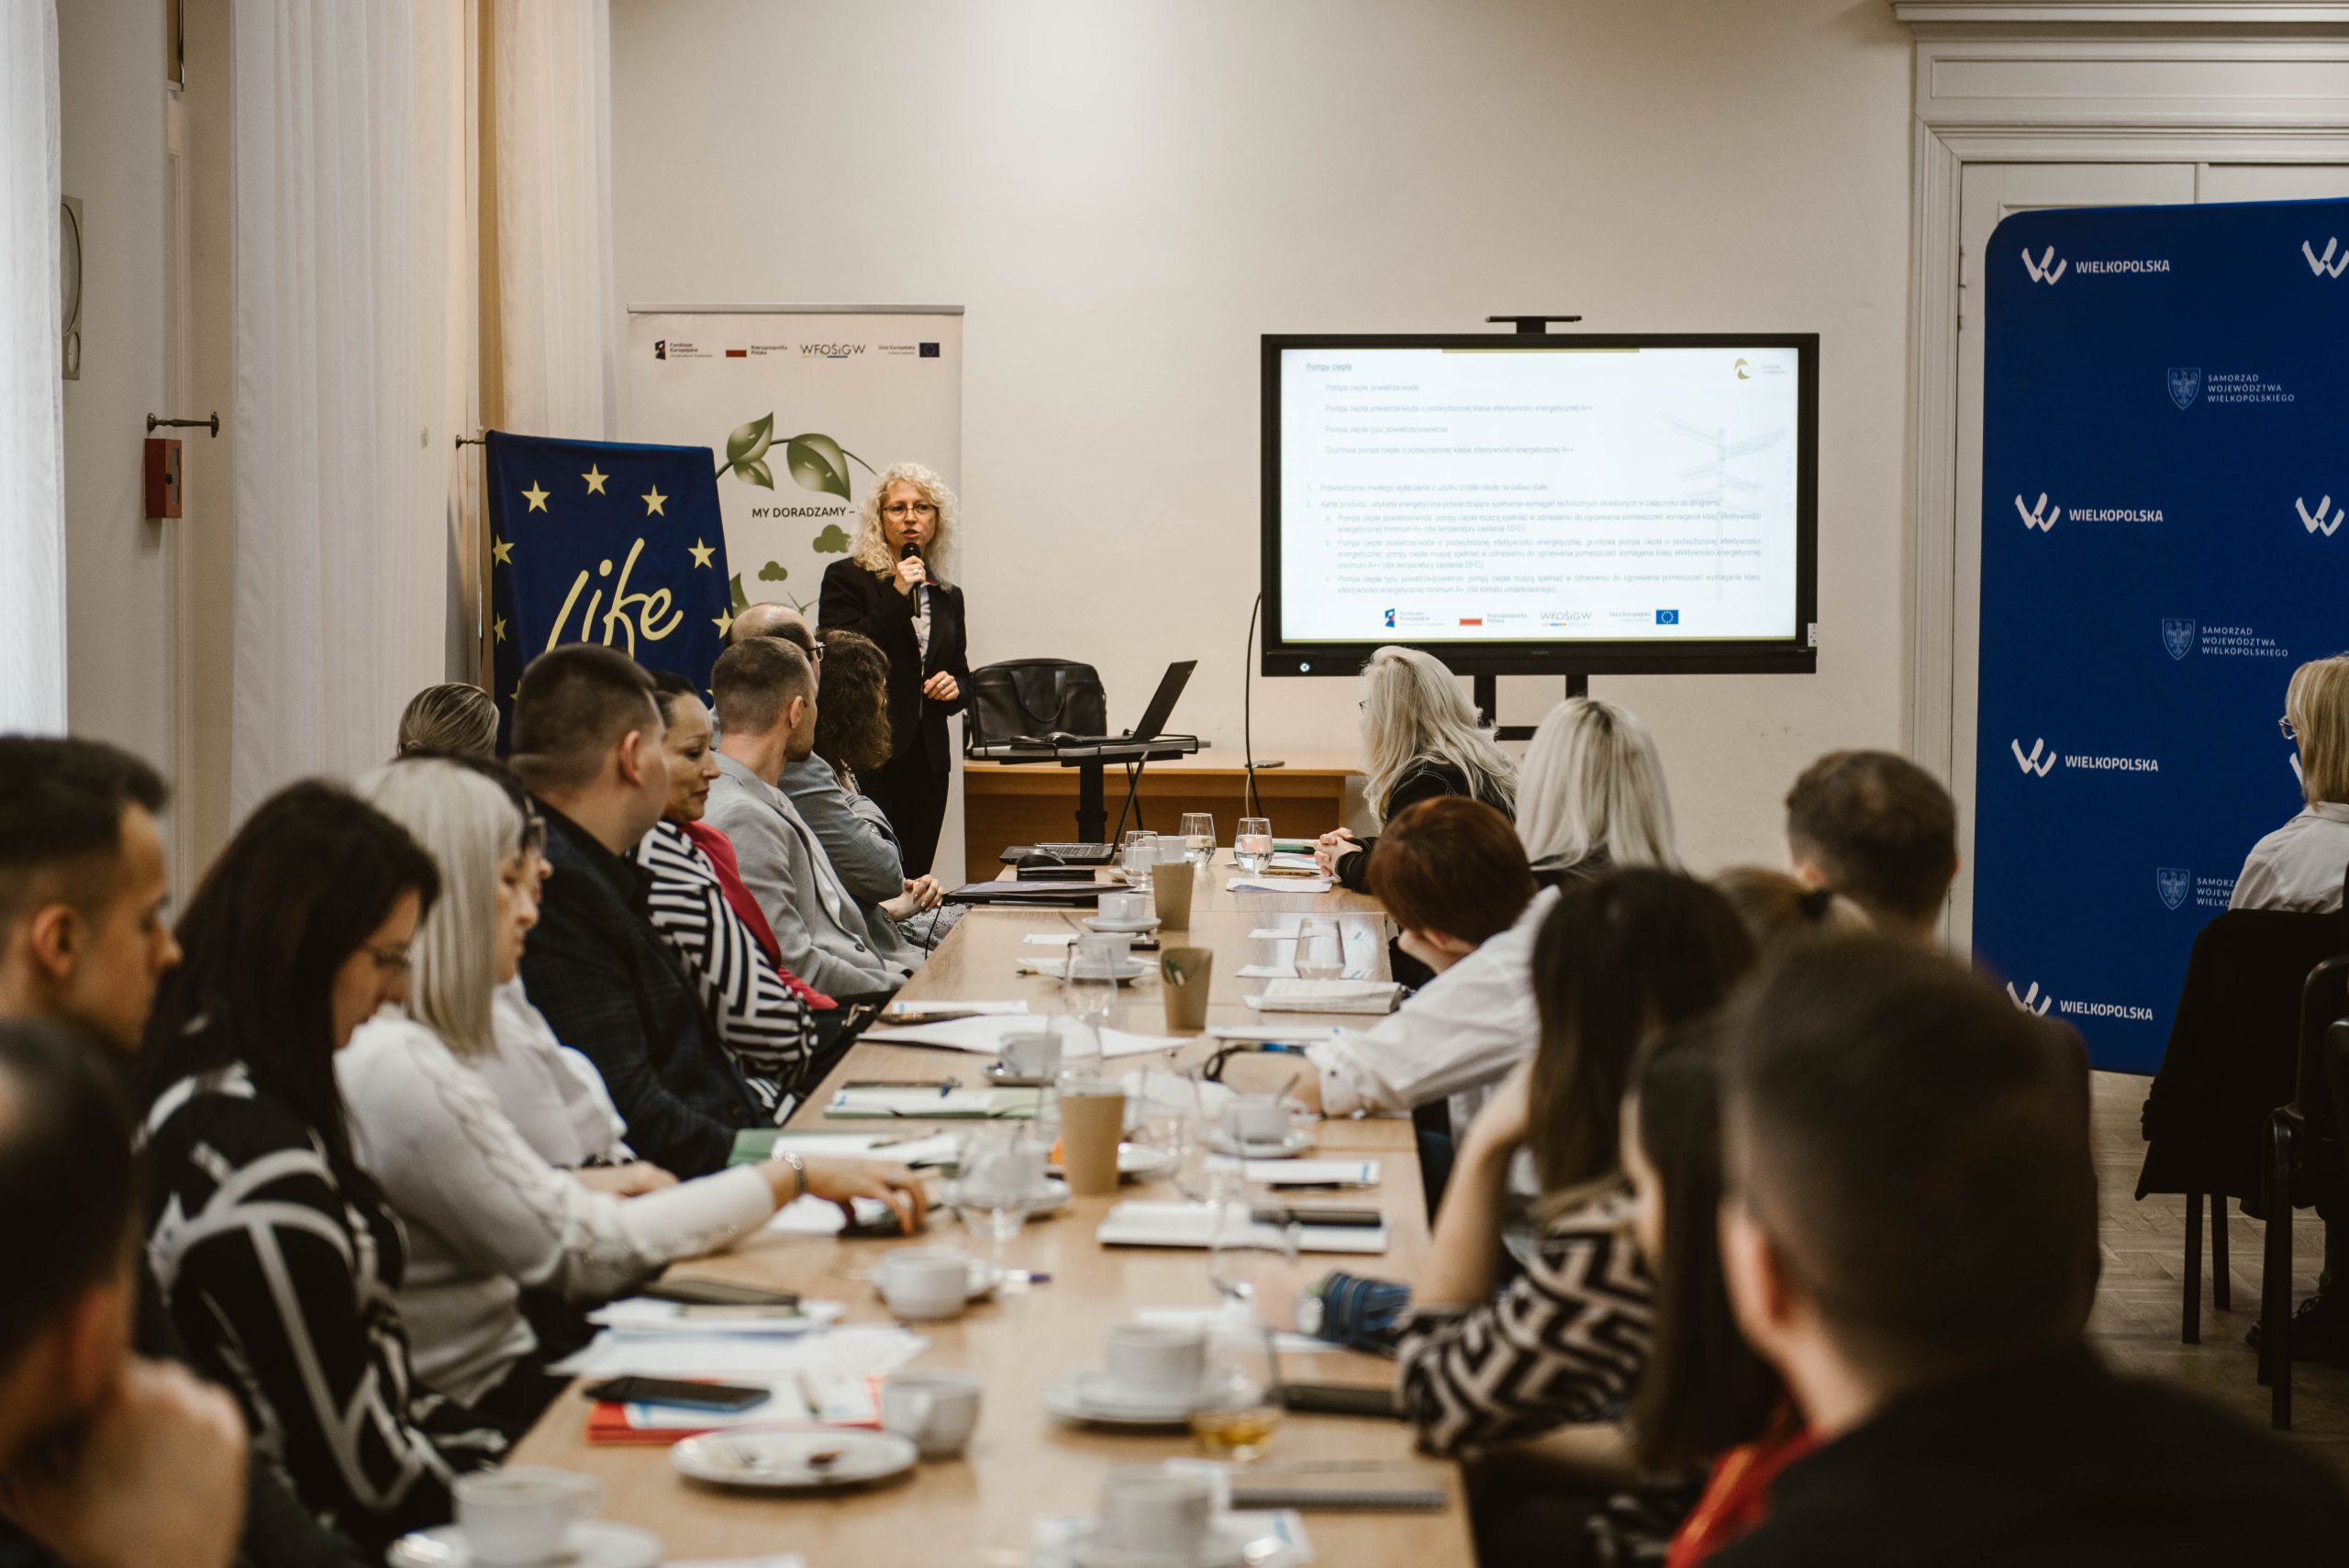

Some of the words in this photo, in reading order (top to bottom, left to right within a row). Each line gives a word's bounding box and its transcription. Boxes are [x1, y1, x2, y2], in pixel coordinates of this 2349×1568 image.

[2076, 260, 2170, 273] WIELKOPOLSKA
[2208, 374, 2259, 383] SAMORZĄD
[2208, 384, 2282, 393] WOJEWÓDZTWA
[2208, 394, 2295, 403] WIELKOPOLSKIEGO
[751, 508, 770, 518] MY
[773, 506, 847, 518] DORADZAMY
[2069, 509, 2164, 523] WIELKOPOLSKA
[2202, 626, 2253, 636] SAMORZĄD
[2202, 637, 2276, 646] WOJEWÓDZTWA
[2202, 647, 2288, 657] WIELKOPOLSKIEGO
[2065, 754, 2159, 773] WIELKOPOLSKA
[2197, 877, 2235, 887] SAMORZ
[2060, 1000, 2154, 1020] WIELKOPOLSKA
